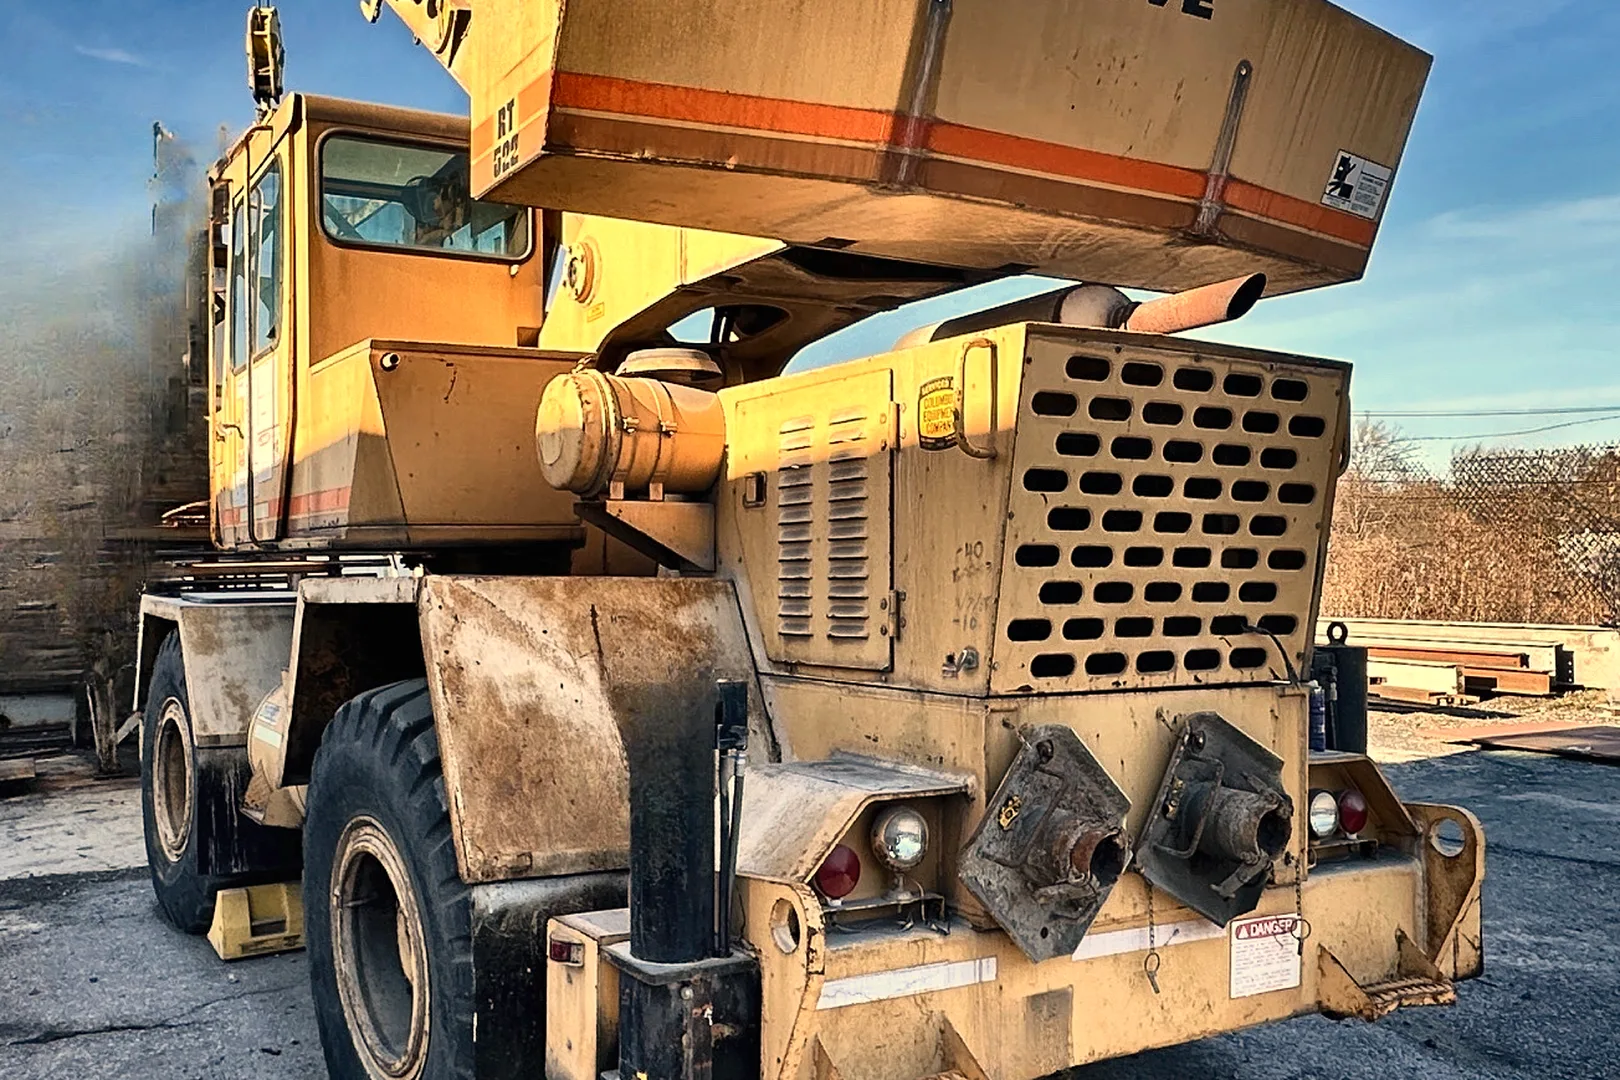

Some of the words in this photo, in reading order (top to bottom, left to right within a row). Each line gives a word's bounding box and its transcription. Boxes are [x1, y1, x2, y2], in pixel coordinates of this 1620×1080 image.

[498, 98, 515, 139] RT
[924, 393, 954, 409] COLUMBU
[923, 406, 954, 422] EQUIPMEN
[926, 420, 952, 435] COMPAN
[1250, 919, 1293, 937] DANGER
